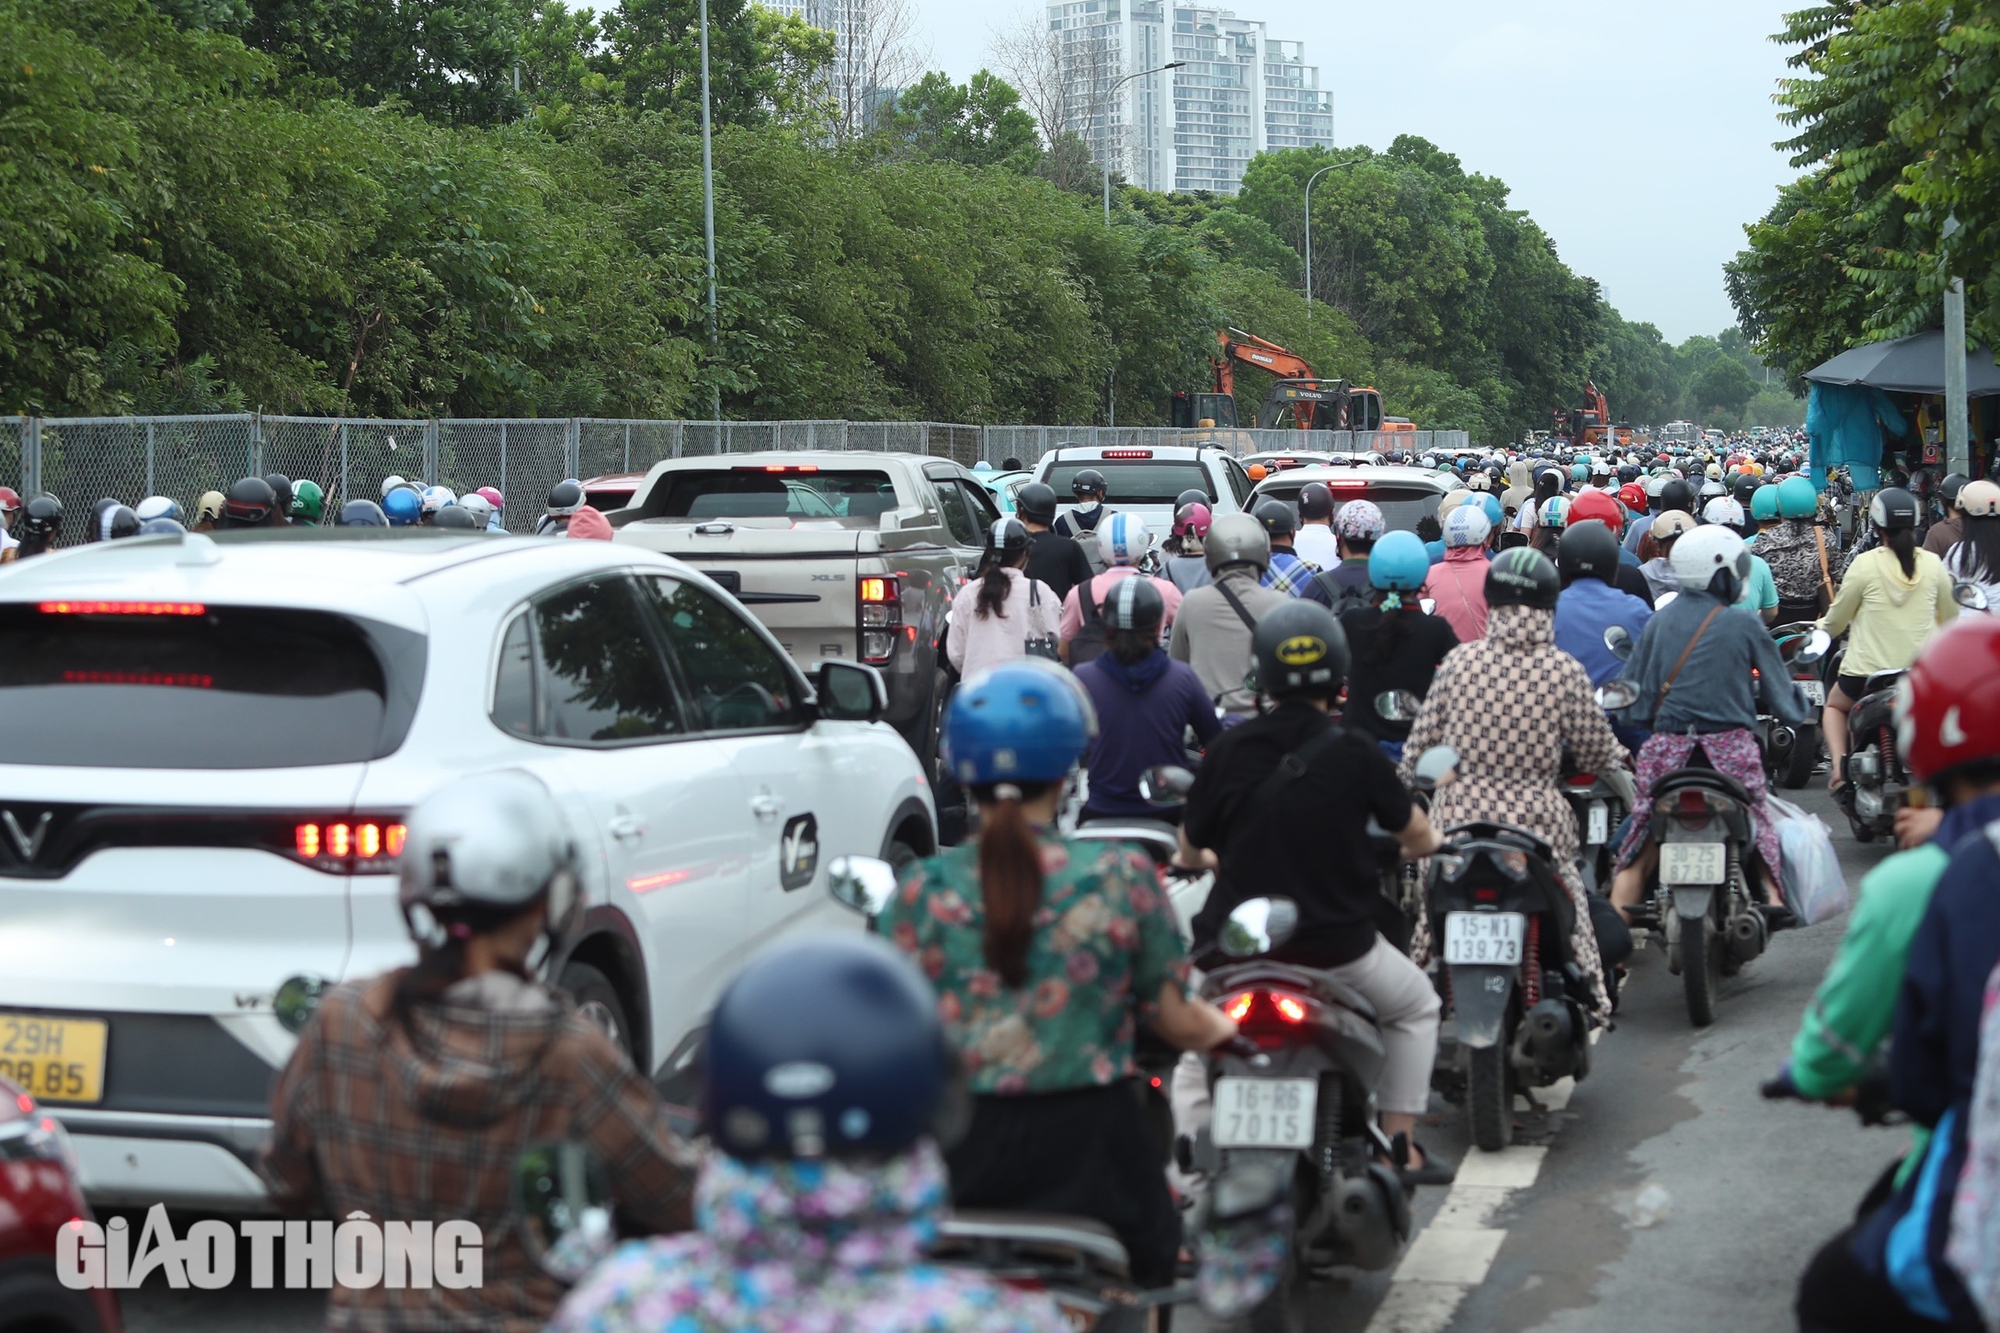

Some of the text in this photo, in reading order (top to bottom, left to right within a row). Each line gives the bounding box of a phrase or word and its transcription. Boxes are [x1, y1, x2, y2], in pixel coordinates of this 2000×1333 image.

[1300, 391, 1322, 399] VOLVO
[1670, 864, 1715, 880] 8736
[1453, 940, 1516, 960] 139.73
[4, 1021, 65, 1055] 29H
[1235, 1084, 1300, 1111] 16-R6
[1228, 1114, 1299, 1141] 7015
